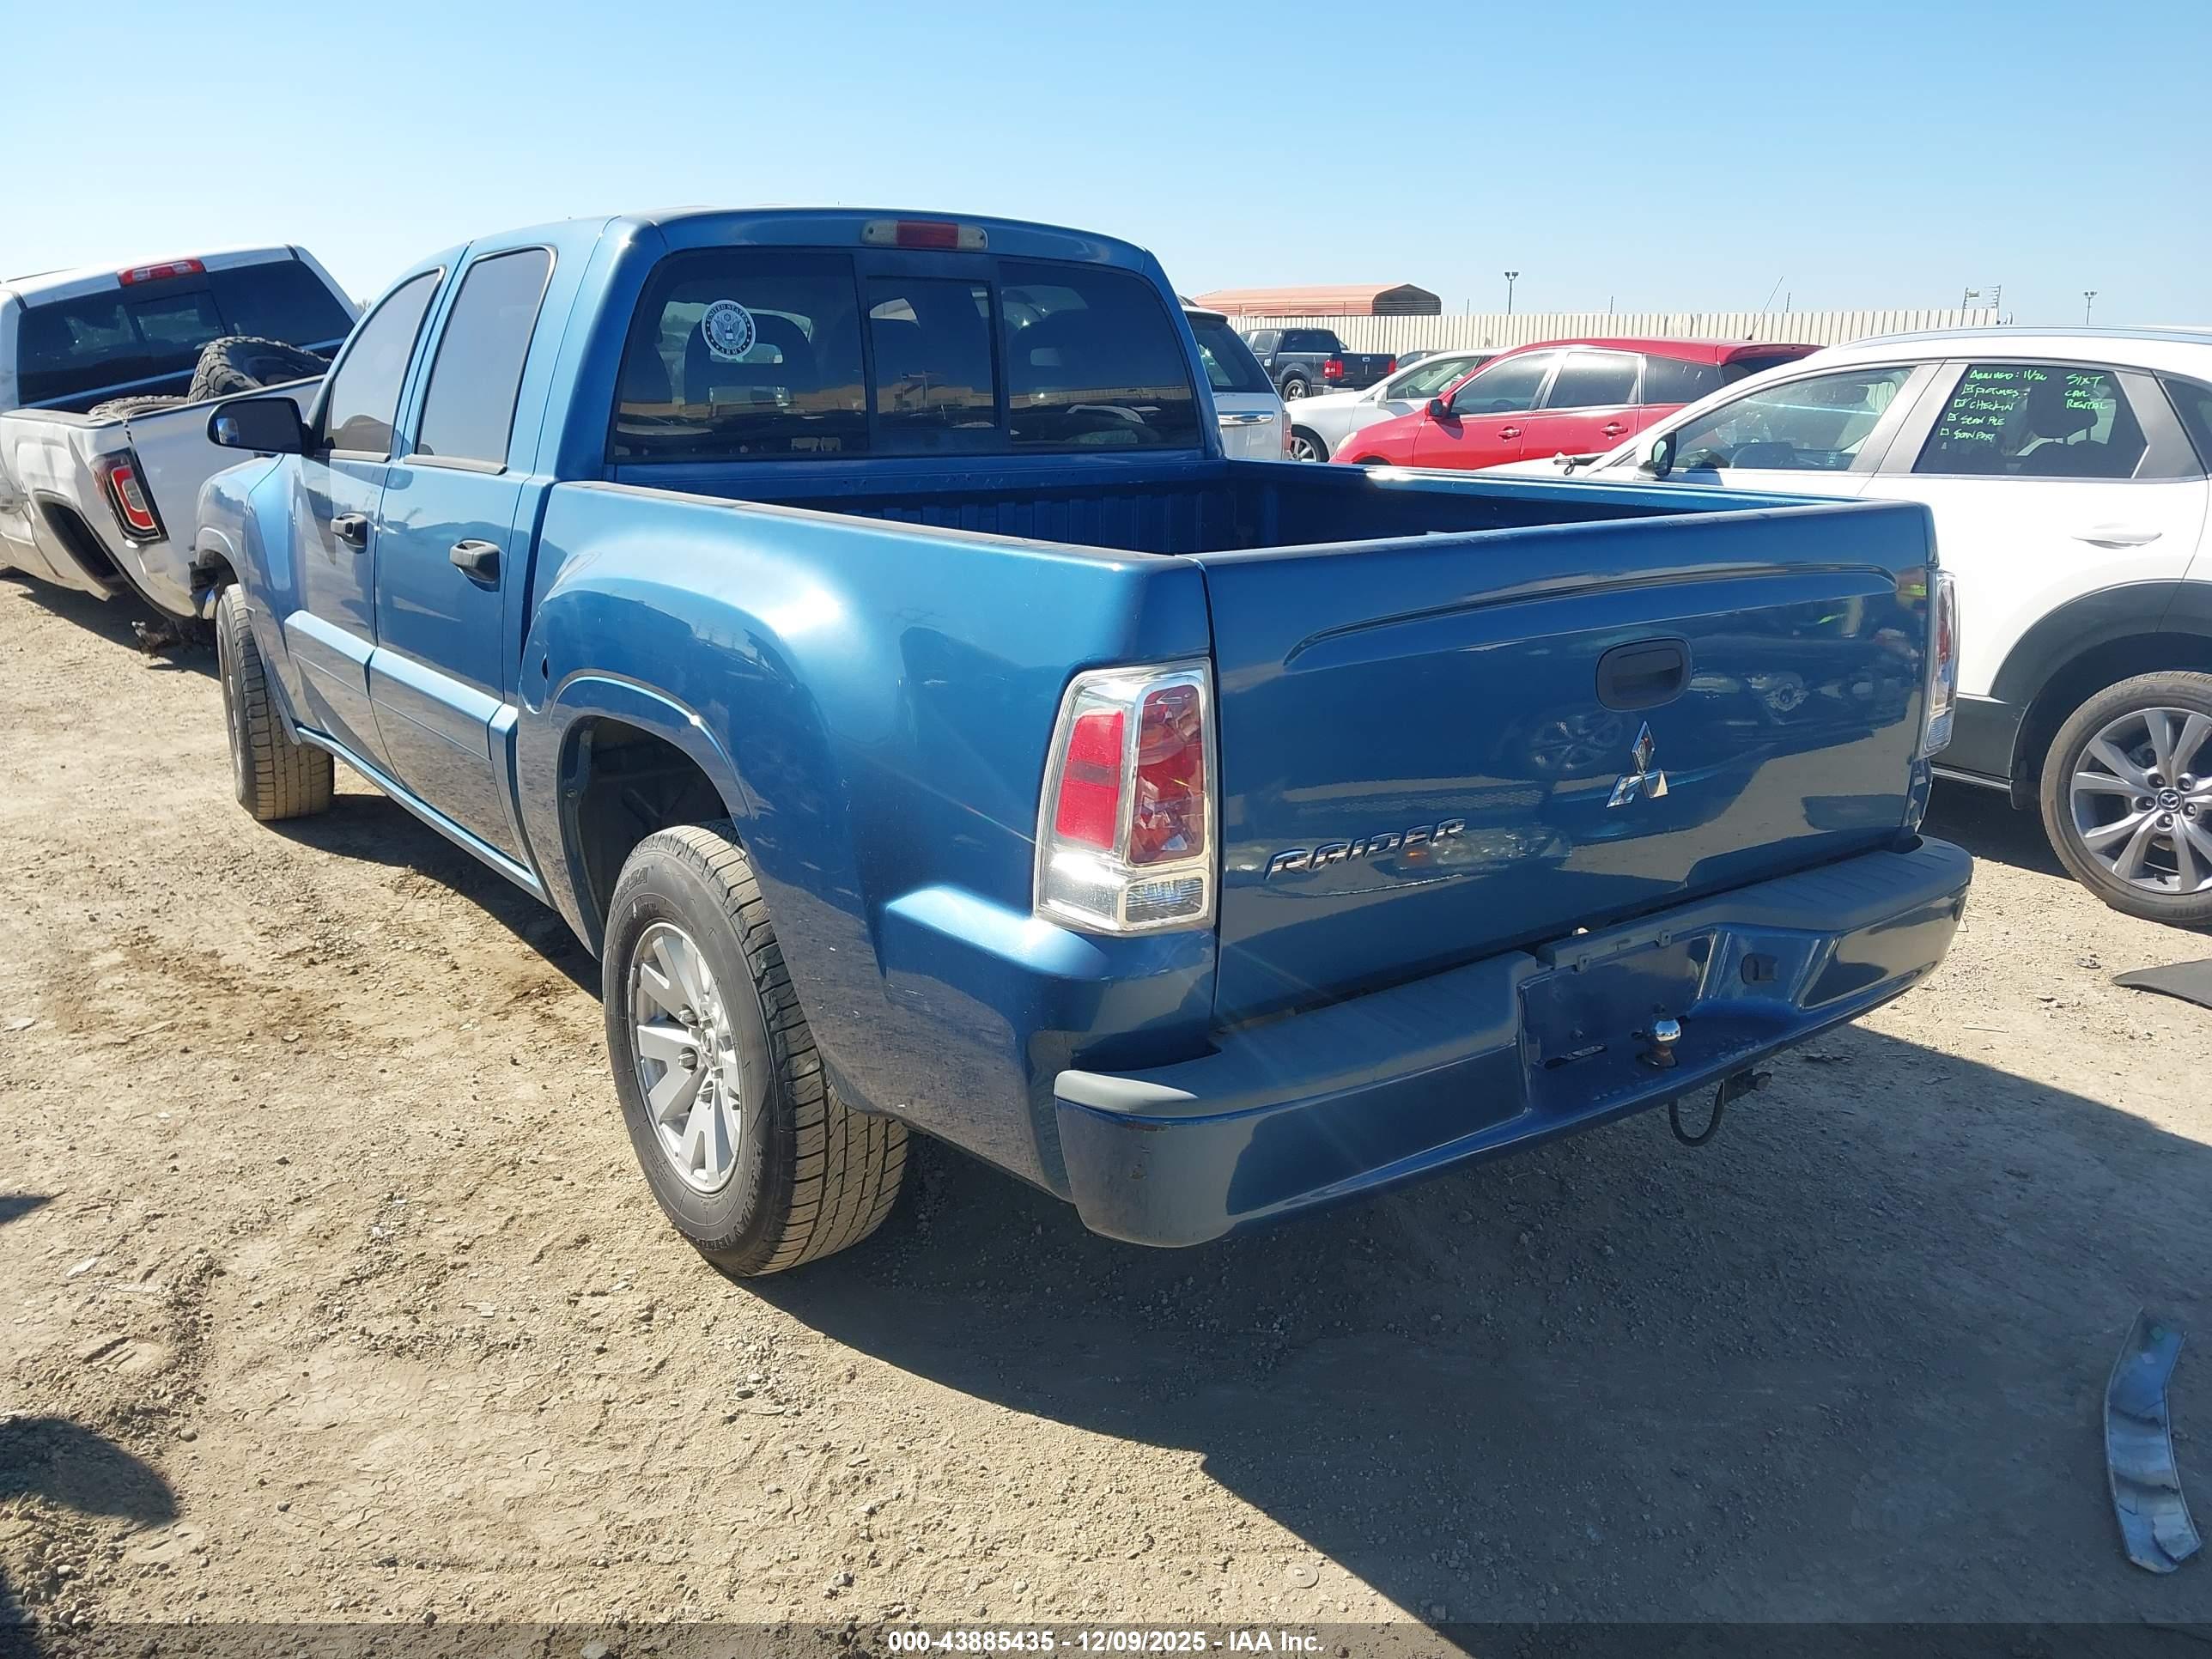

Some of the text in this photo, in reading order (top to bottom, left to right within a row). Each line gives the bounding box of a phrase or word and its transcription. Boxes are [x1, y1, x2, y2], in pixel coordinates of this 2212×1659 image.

[706, 303, 749, 323] UNITED STATES
[2065, 373, 2105, 389] SIXT
[2064, 389, 2091, 398] CAR
[2066, 398, 2108, 410] RENTAL
[1960, 414, 1985, 425] SCAN
[1263, 818, 1467, 880] RAIDER
